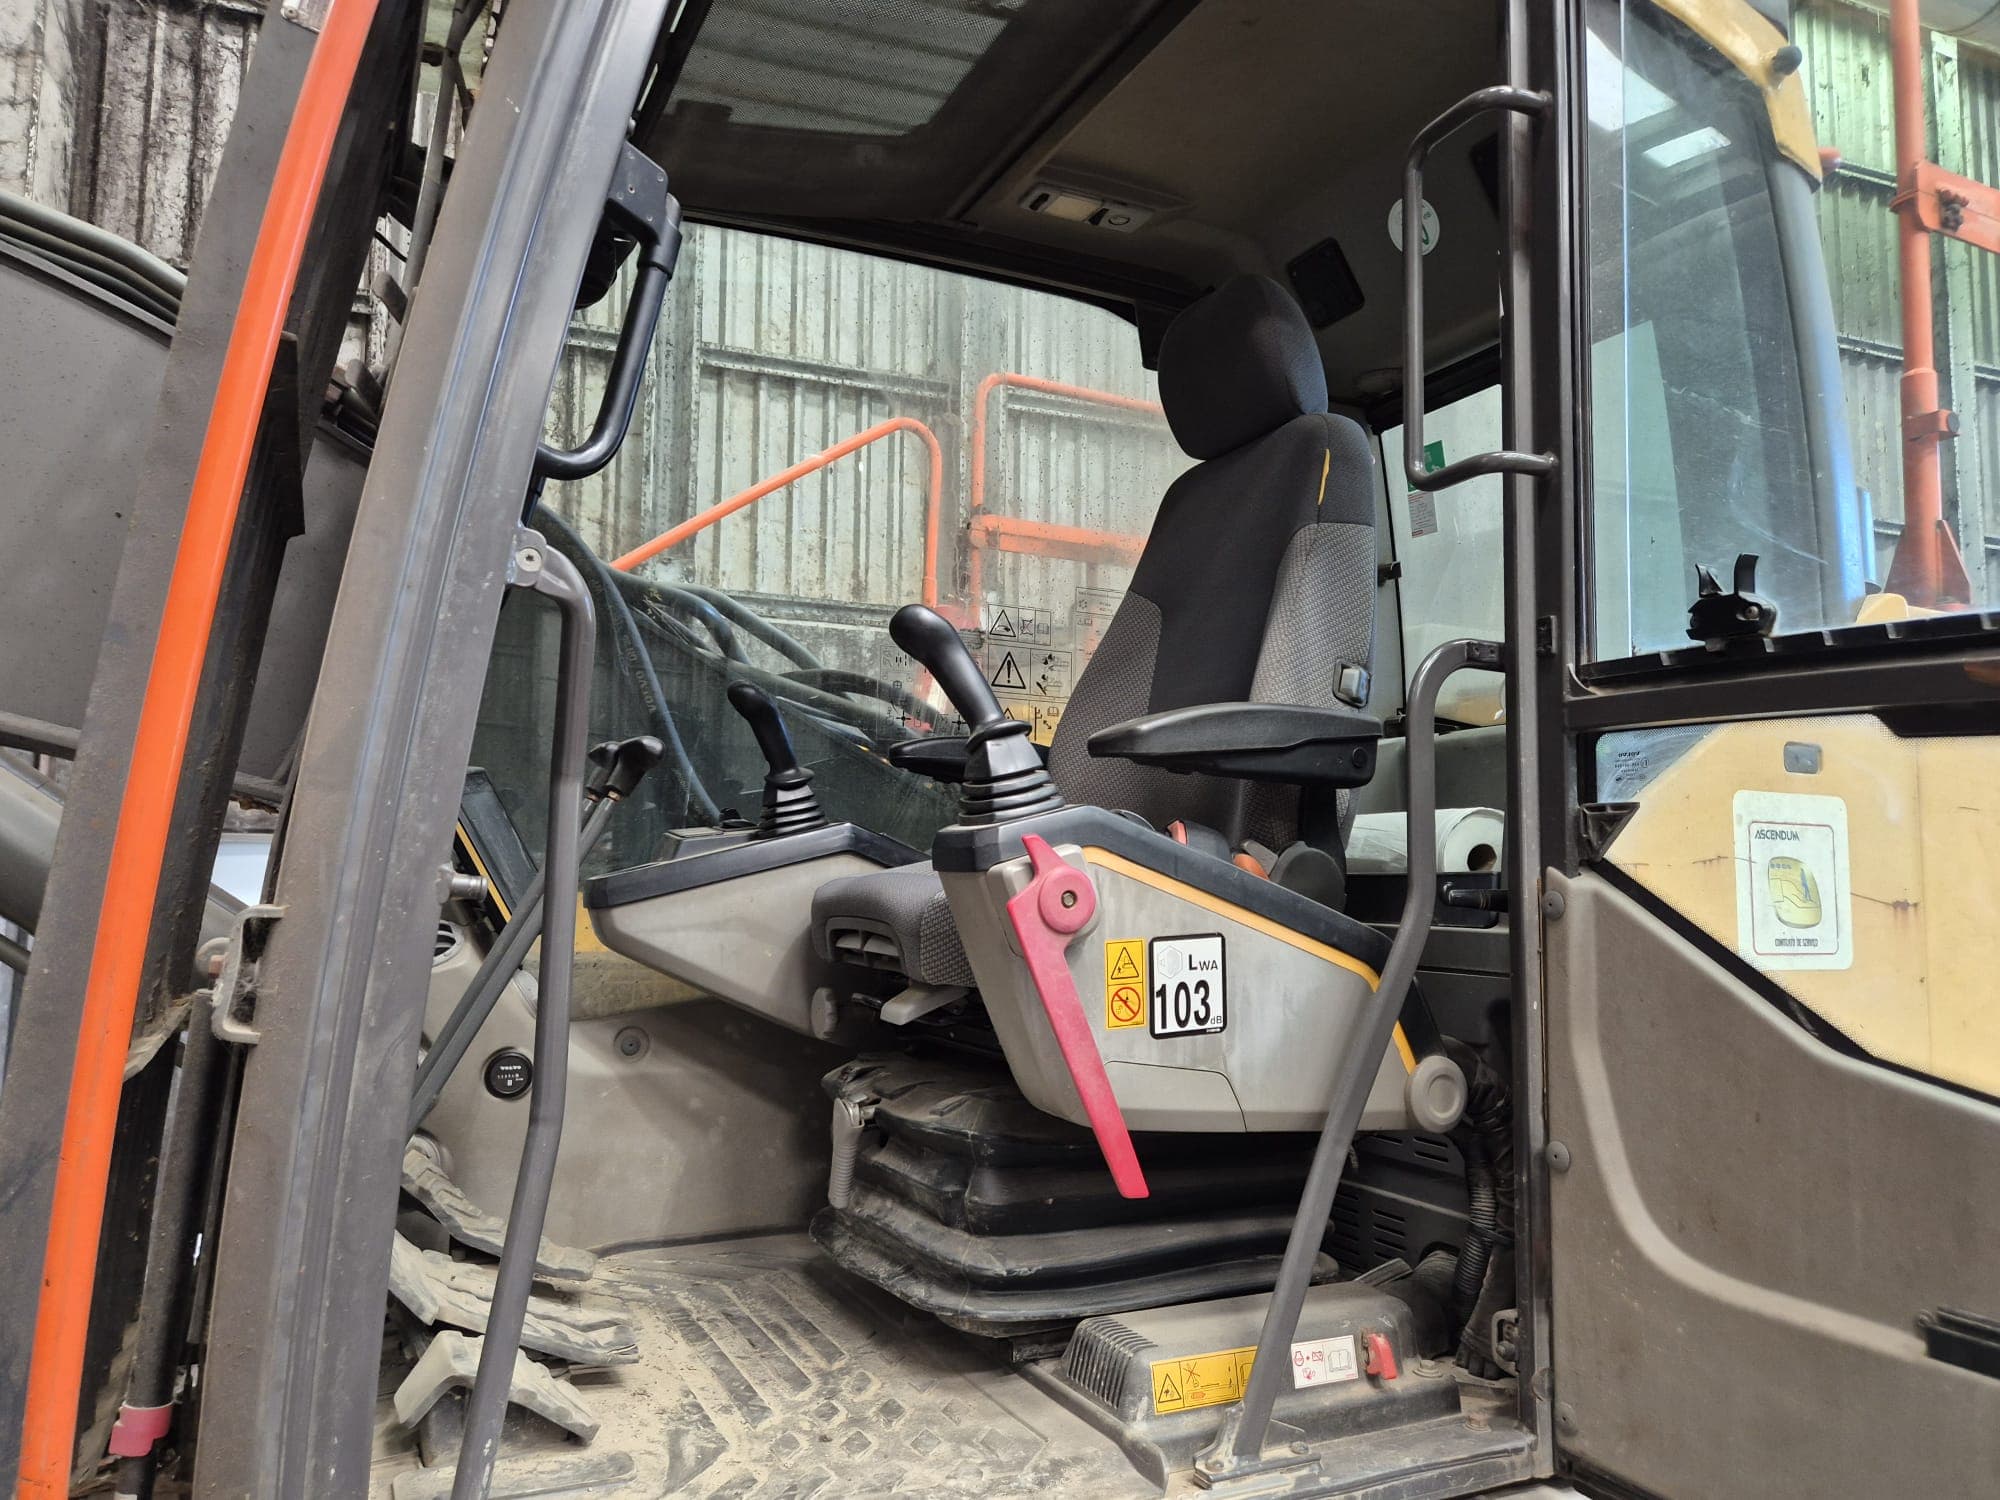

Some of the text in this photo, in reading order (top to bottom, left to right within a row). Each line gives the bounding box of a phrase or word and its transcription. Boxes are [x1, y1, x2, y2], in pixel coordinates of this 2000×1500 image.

[1754, 829, 1800, 841] ASCENDUM
[1155, 980, 1223, 1030] 103 dB
